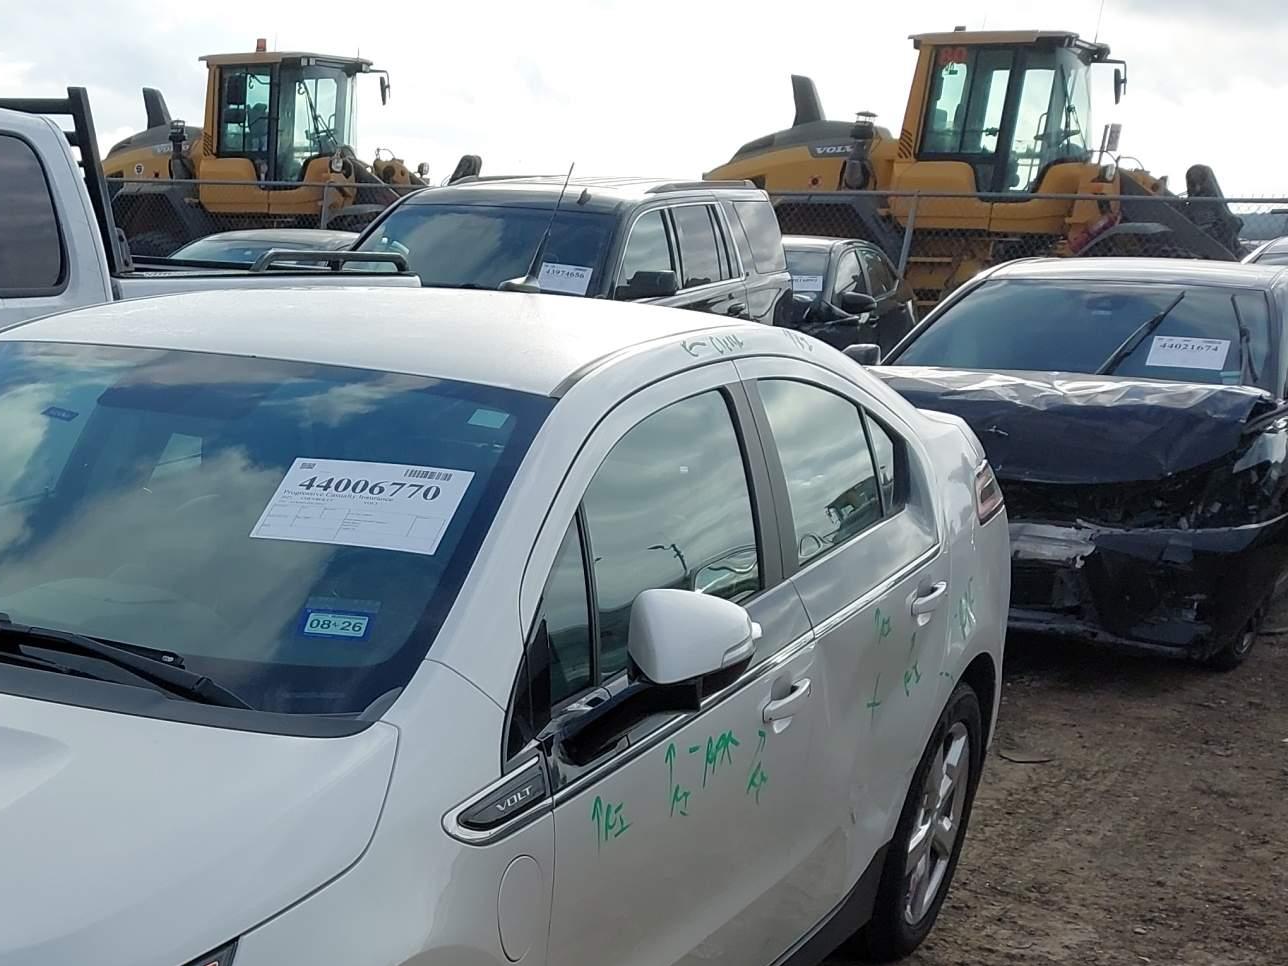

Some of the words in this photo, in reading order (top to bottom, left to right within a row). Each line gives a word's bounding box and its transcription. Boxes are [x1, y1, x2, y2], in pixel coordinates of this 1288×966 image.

[1159, 342, 1219, 352] 44021674
[298, 475, 441, 501] 44006770
[495, 785, 533, 812] VOLT
